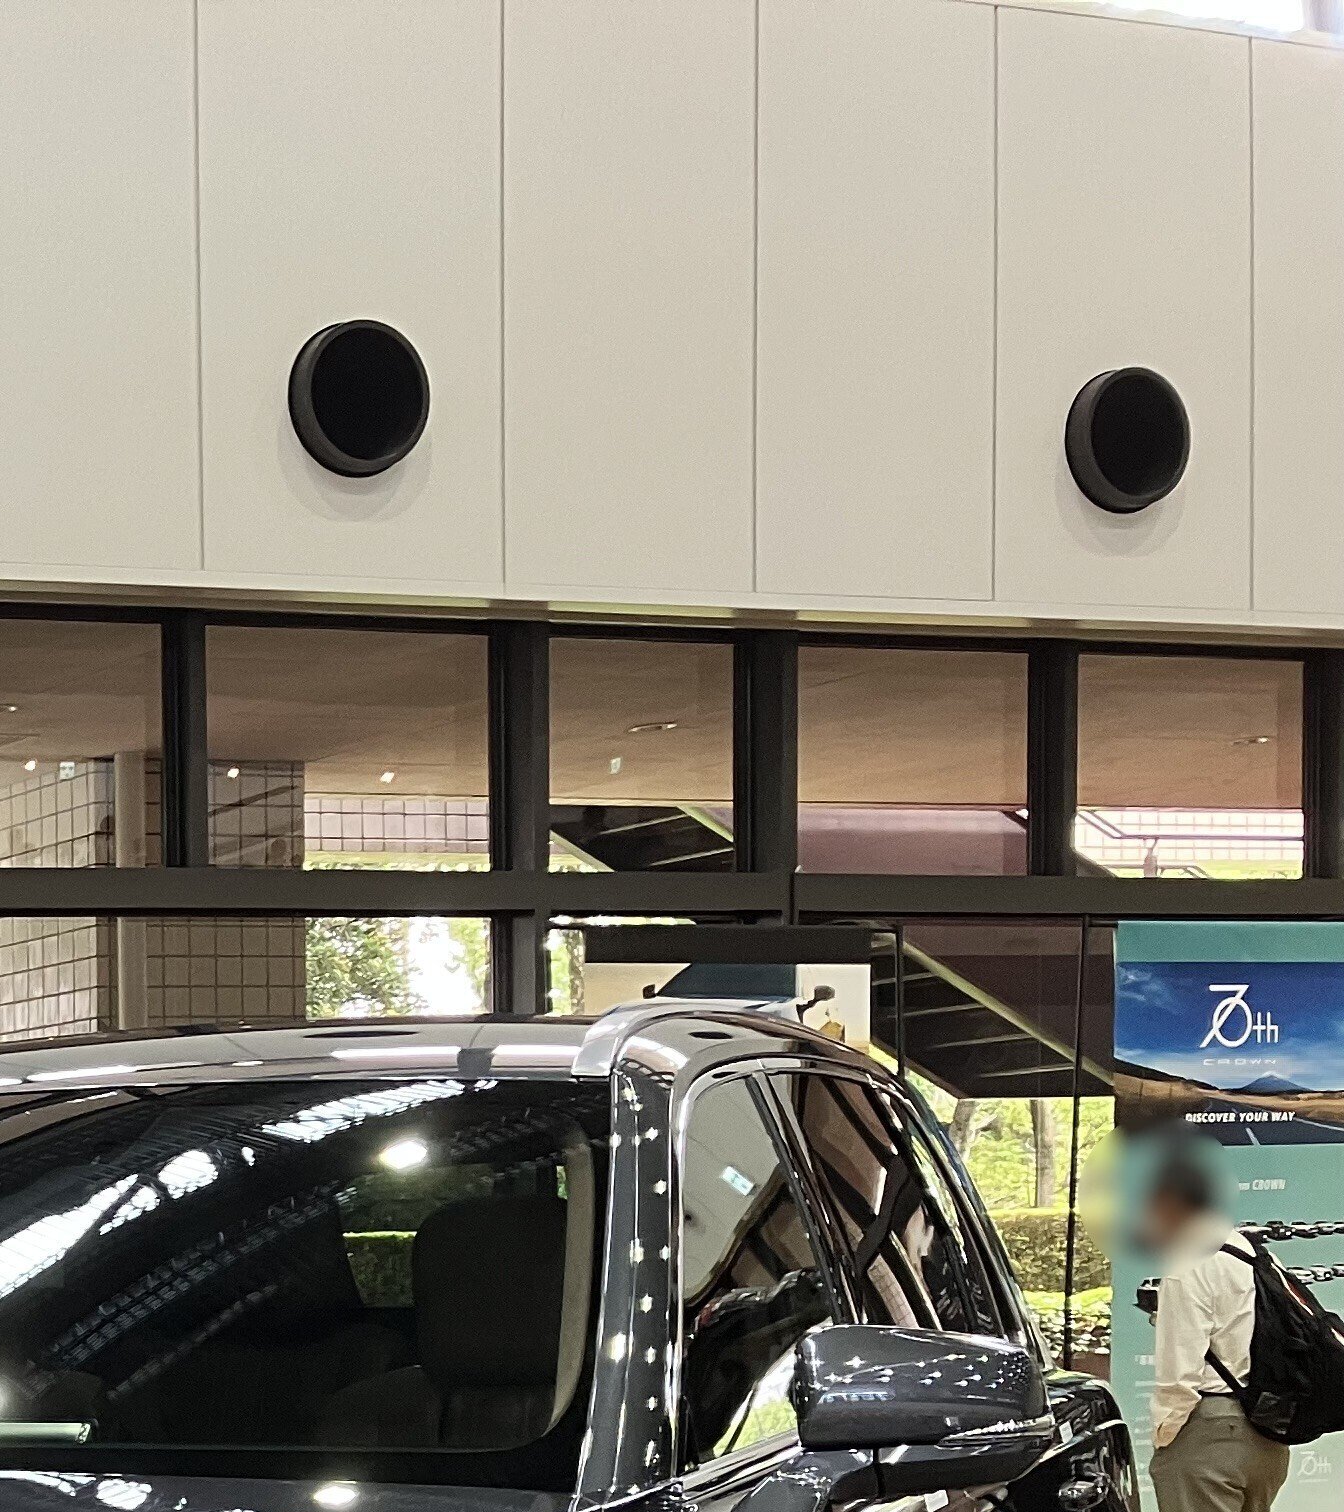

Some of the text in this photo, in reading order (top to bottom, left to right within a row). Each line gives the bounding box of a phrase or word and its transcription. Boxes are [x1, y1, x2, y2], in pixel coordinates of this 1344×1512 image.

[1185, 1111, 1295, 1122] DISCOVER YOUR WAY
